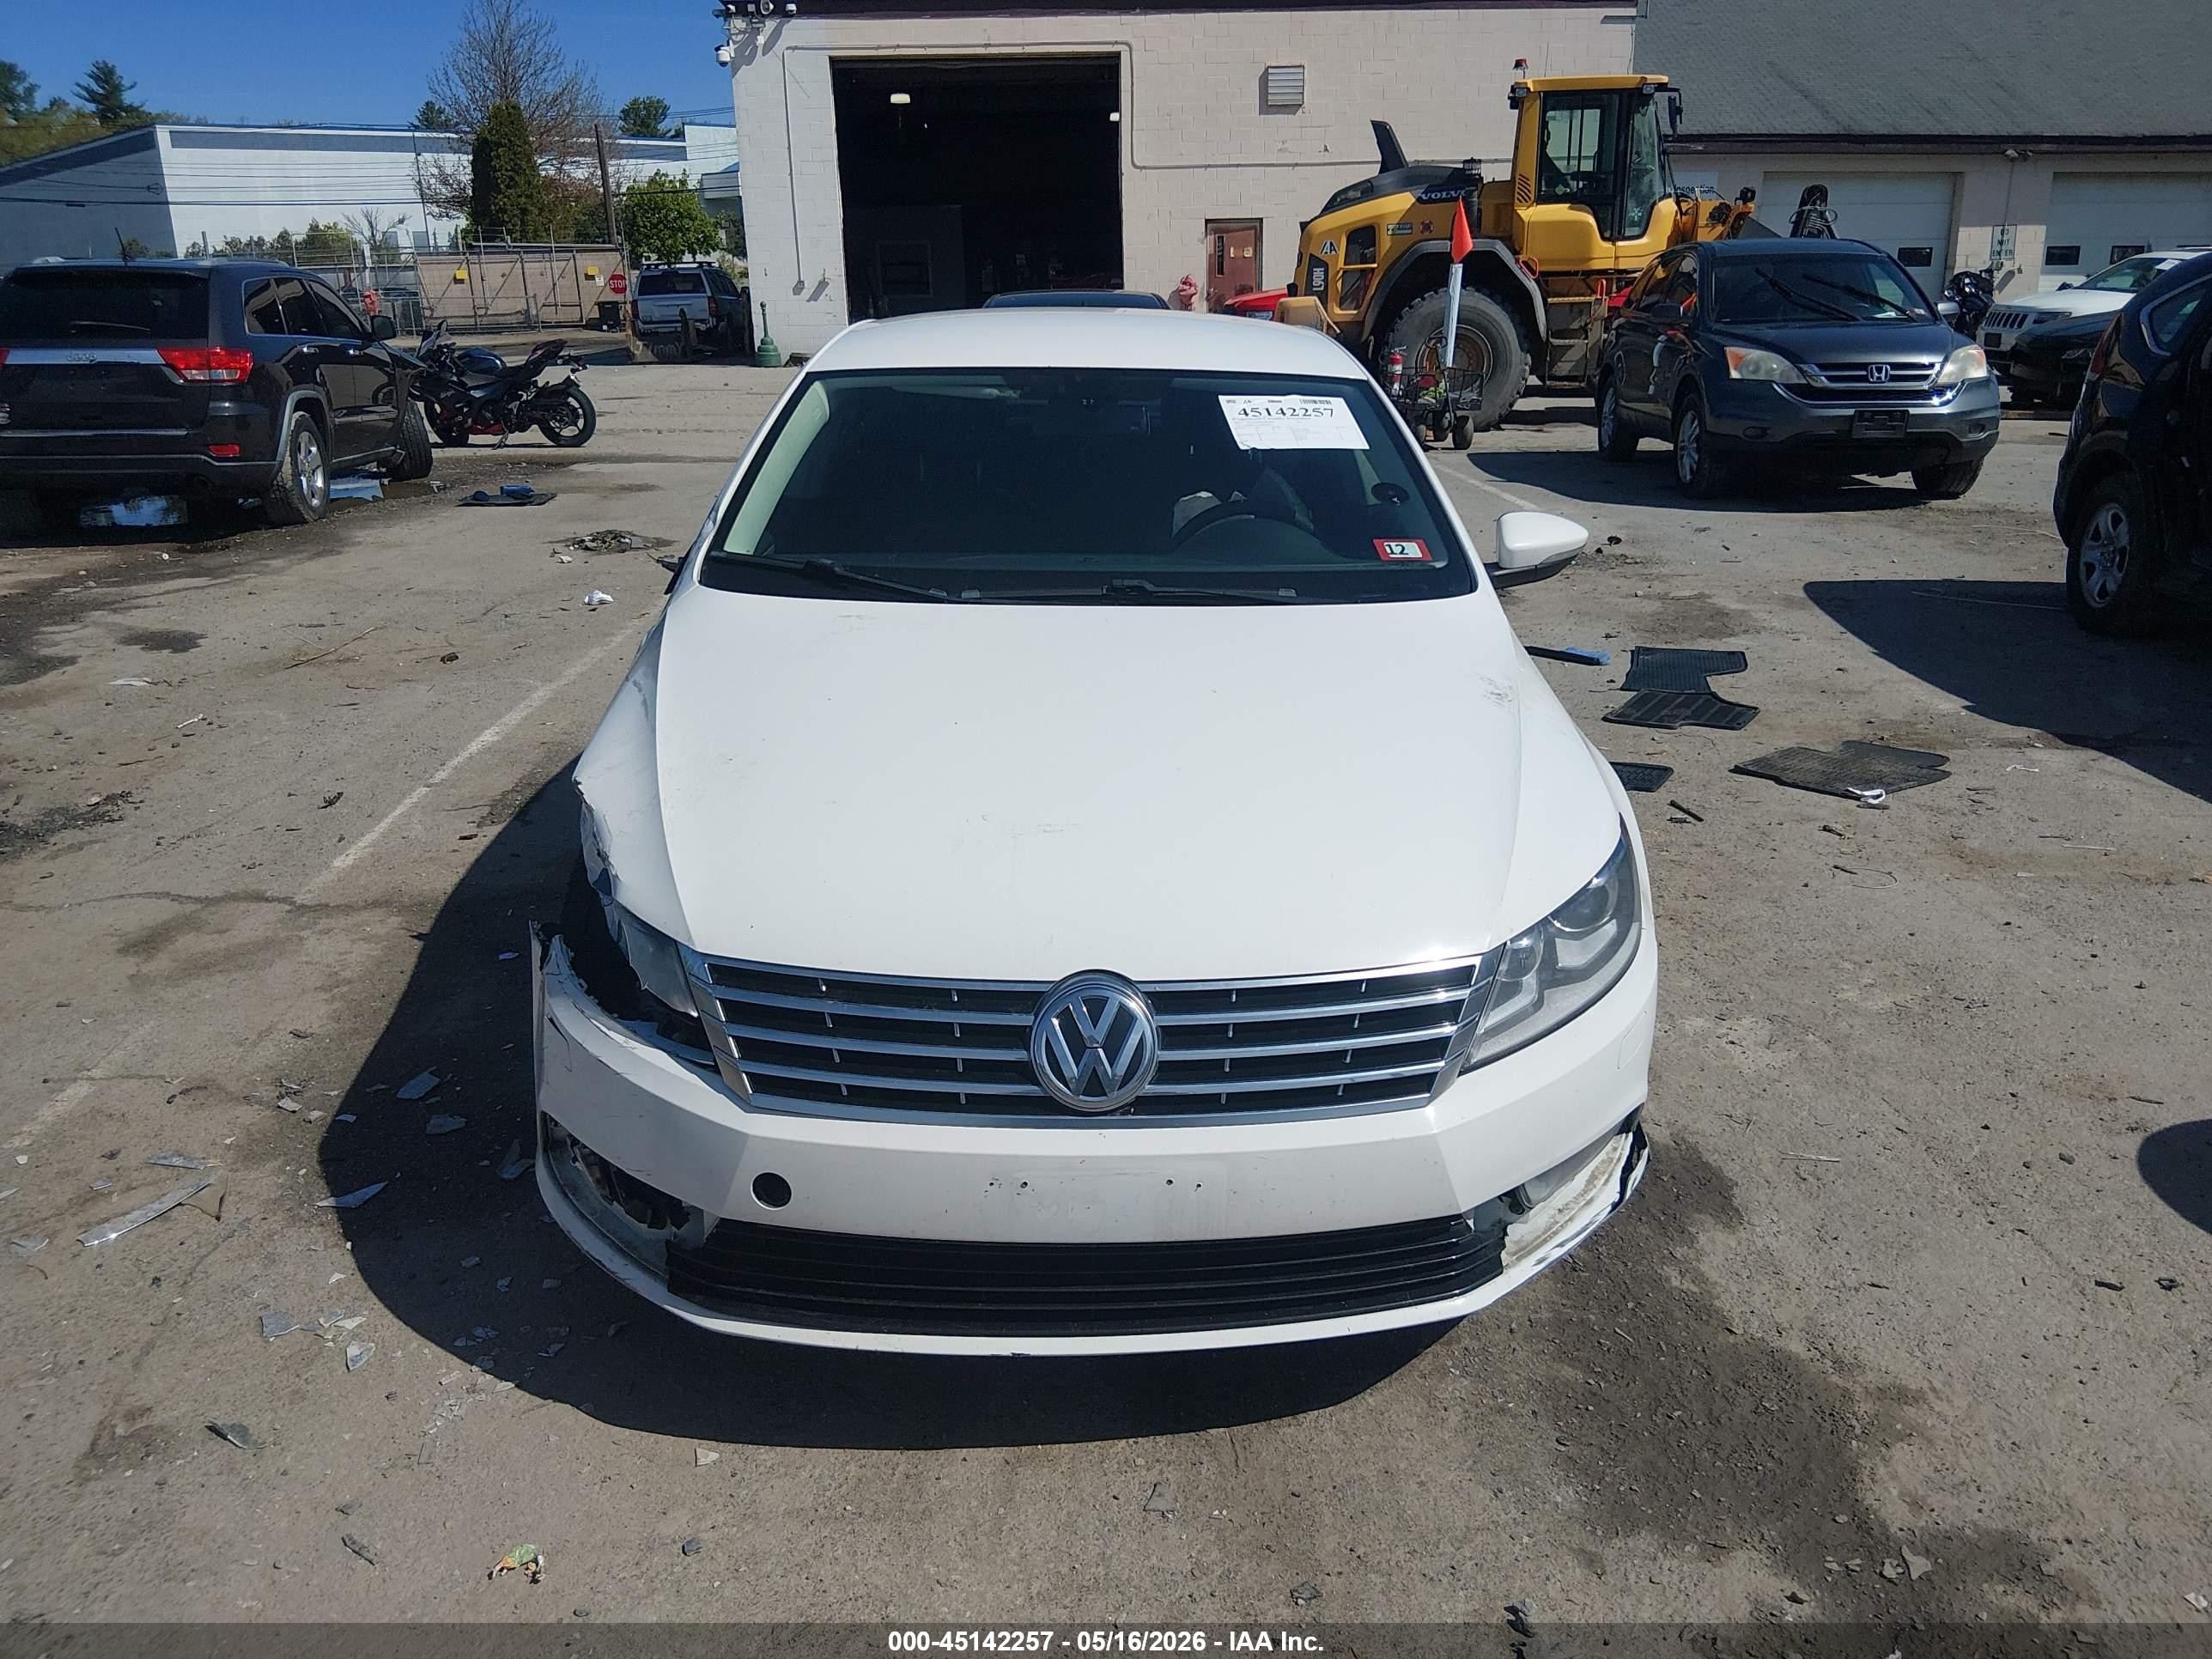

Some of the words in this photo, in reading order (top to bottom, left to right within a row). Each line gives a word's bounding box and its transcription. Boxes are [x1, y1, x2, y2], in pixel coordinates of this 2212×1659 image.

[1312, 267, 1324, 291] L90H
[1237, 407, 1334, 417] 45142257
[1385, 544, 1409, 555] 12
